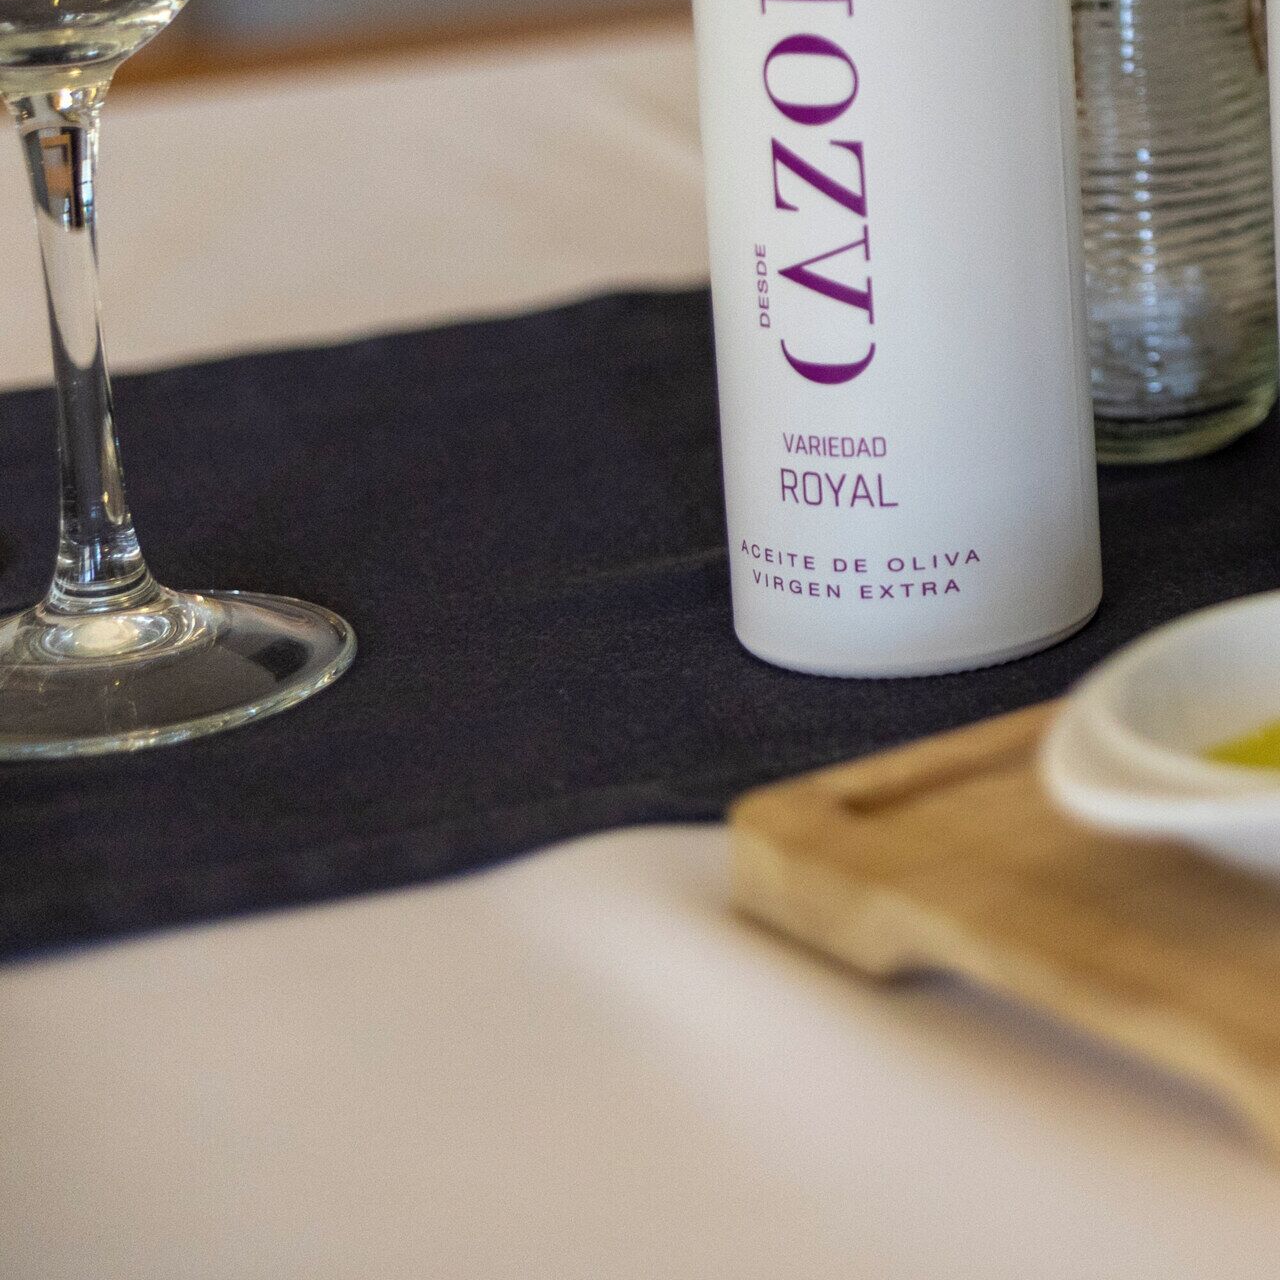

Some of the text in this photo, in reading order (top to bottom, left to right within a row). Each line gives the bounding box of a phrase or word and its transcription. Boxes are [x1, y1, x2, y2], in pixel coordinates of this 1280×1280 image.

[754, 242, 771, 329] DESDE
[782, 432, 888, 458] VARIEDAD
[780, 468, 899, 508] ROYAL
[740, 538, 981, 573] ACEITE DE OLIVA
[752, 568, 961, 600] VIRGEN EXTRA
